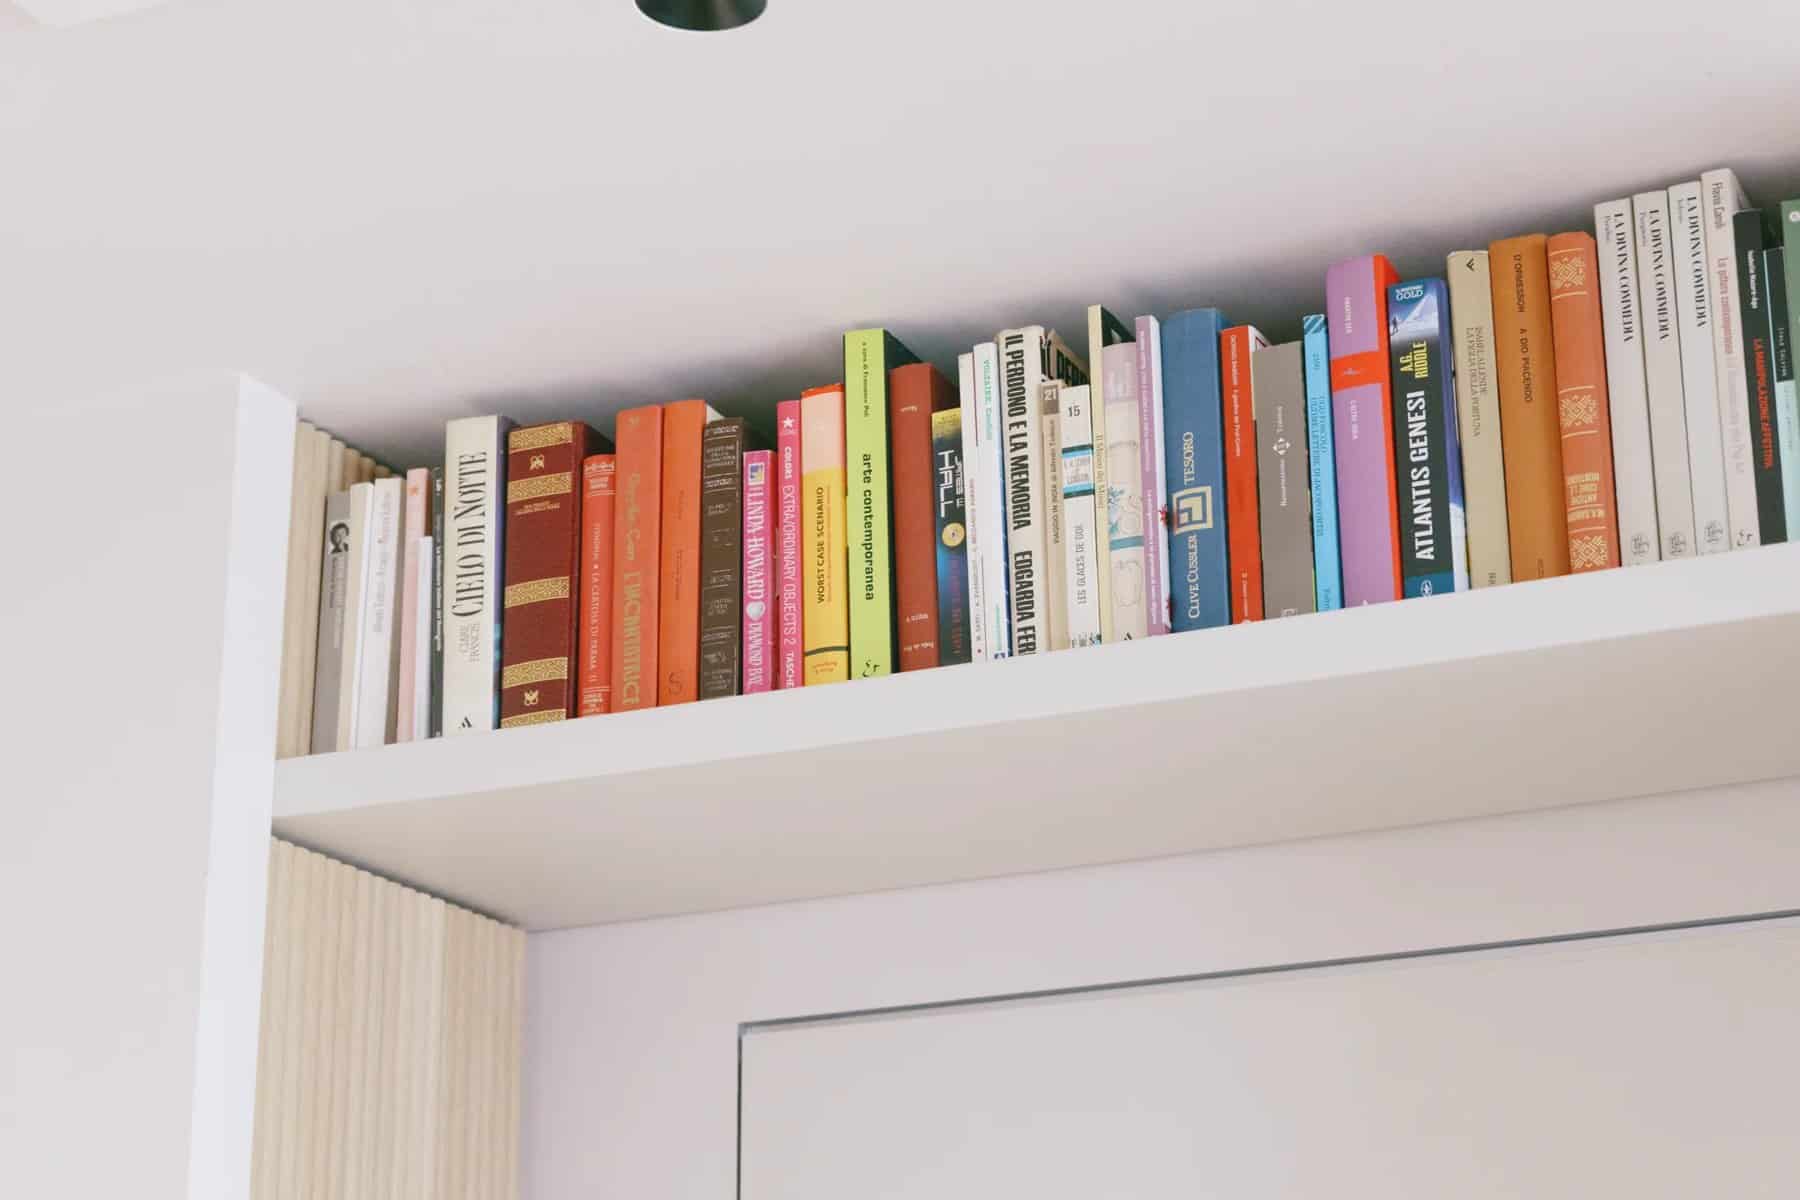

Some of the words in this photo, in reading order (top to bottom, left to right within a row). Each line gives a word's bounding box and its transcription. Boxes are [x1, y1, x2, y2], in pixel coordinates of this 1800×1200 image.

[1613, 213, 1625, 228] LA
[1649, 209, 1660, 225] LA
[1687, 196, 1698, 212] LA
[1617, 232, 1629, 274] DIVINA
[1652, 229, 1664, 271] DIVINA
[1689, 215, 1702, 258] DIVINA
[1620, 276, 1635, 343] COMMEDIA
[1655, 273, 1670, 340] COMMEDIA
[1692, 260, 1708, 328] COMMEDIA
[1005, 334, 1024, 349] IL
[1414, 341, 1429, 379] RIDDLE
[1520, 338, 1529, 354] DIO
[1753, 338, 1762, 351] LA
[1005, 350, 1026, 417] PERDONO
[1400, 352, 1413, 374] A.G.
[1521, 357, 1534, 403] PIACENDO
[1044, 389, 1057, 401] 21
[1068, 405, 1081, 417] 15
[1009, 421, 1028, 430] E
[1009, 434, 1029, 453] LA
[1406, 390, 1430, 463] GENESI
[862, 453, 873, 483] arte
[1183, 432, 1195, 485] TESORO
[454, 452, 488, 521] NOTTE
[938, 450, 957, 518] HALL
[1009, 456, 1032, 530] MEMORIA
[746, 493, 764, 534] LINDA
[815, 487, 825, 538] SCENARIO
[1410, 465, 1434, 561] ATLANTIS
[456, 526, 485, 546] DI
[816, 541, 825, 567] CASE
[861, 488, 876, 600] contemporanea
[746, 536, 765, 600] HOWARD
[1187, 533, 1200, 583] CUSSLER
[451, 554, 485, 618] CIELO
[816, 567, 825, 604] WORST
[1014, 551, 1035, 623] EDGARDA
[1188, 584, 1201, 619] CLIVE
[783, 585, 796, 635] OBJECTS
[784, 637, 796, 645] 2
[1017, 625, 1037, 655] FER
